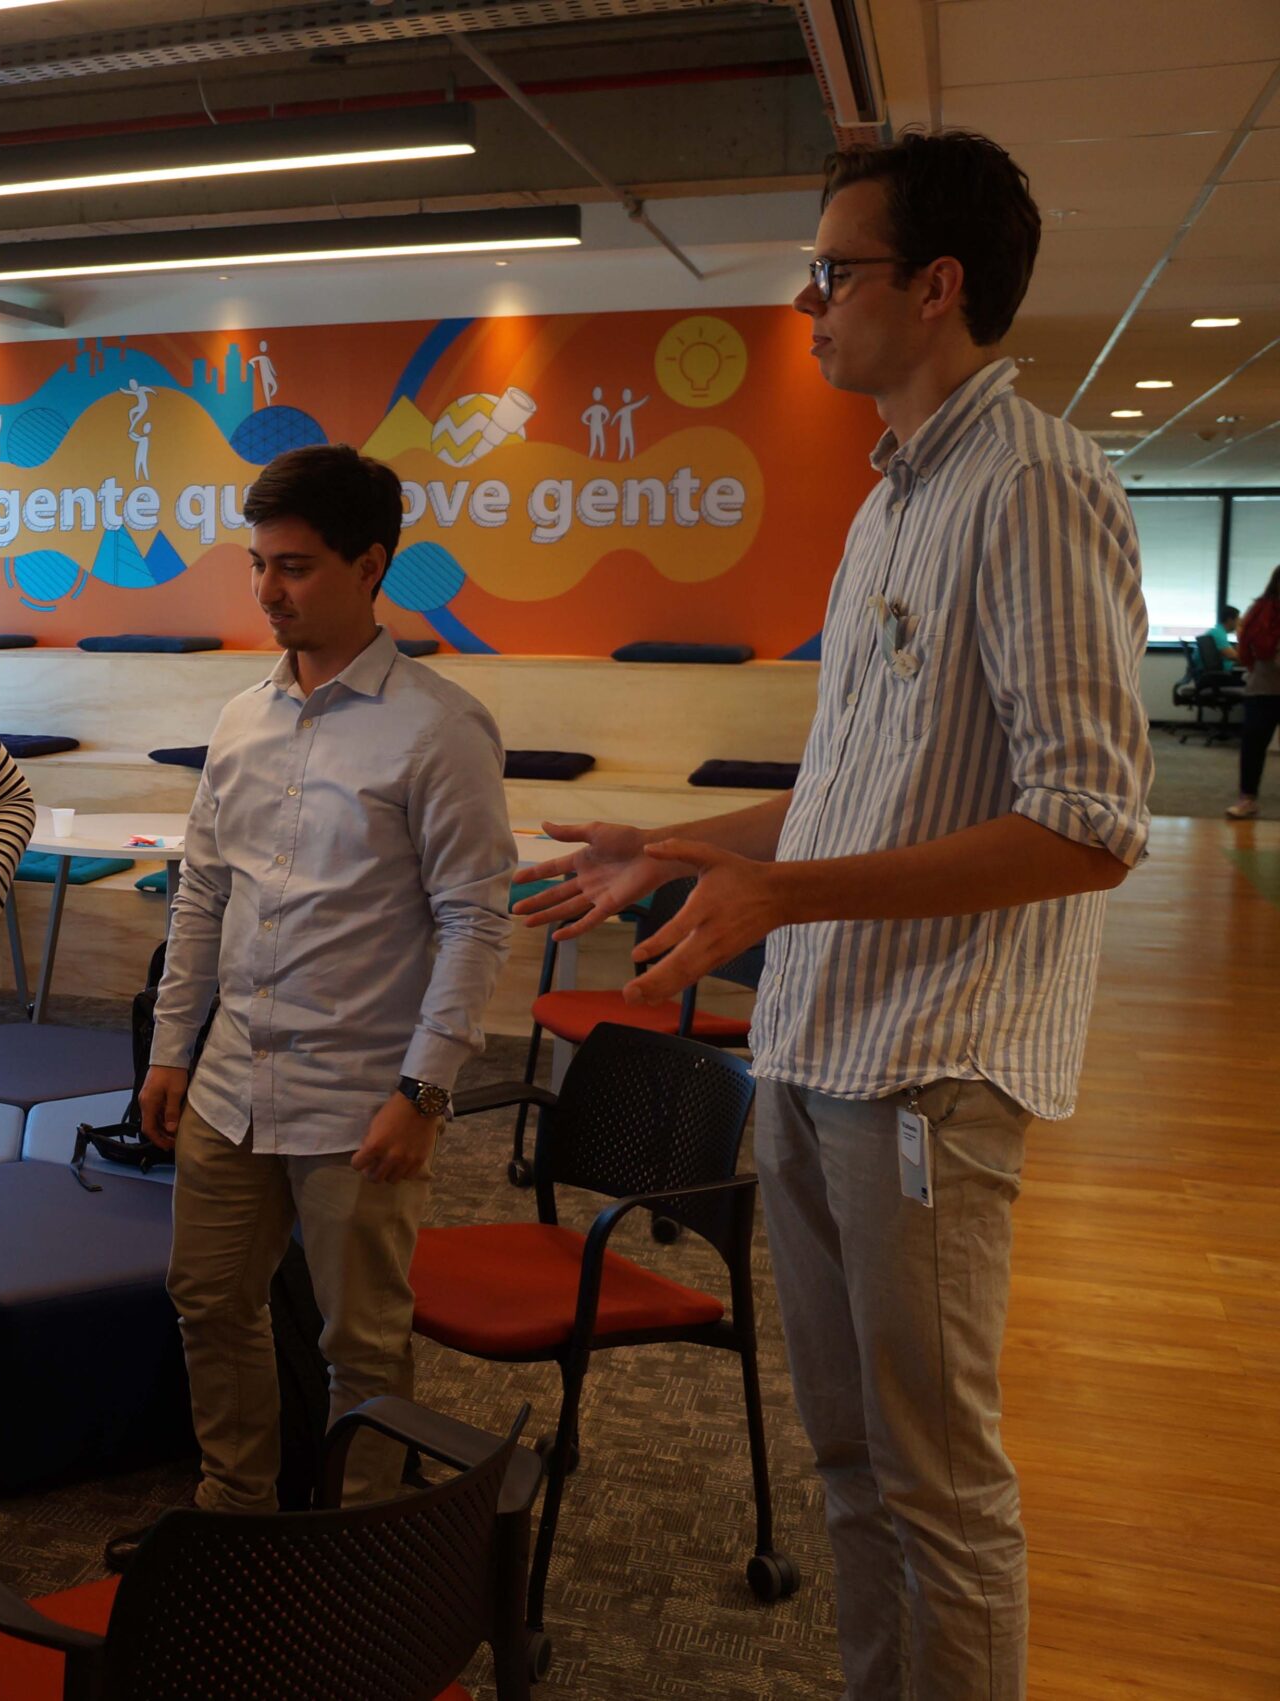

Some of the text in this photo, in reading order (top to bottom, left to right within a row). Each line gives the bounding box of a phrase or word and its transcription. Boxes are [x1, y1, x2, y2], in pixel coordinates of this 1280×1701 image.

[175, 484, 255, 545] qu
[400, 479, 510, 528] ove
[527, 466, 745, 544] gente
